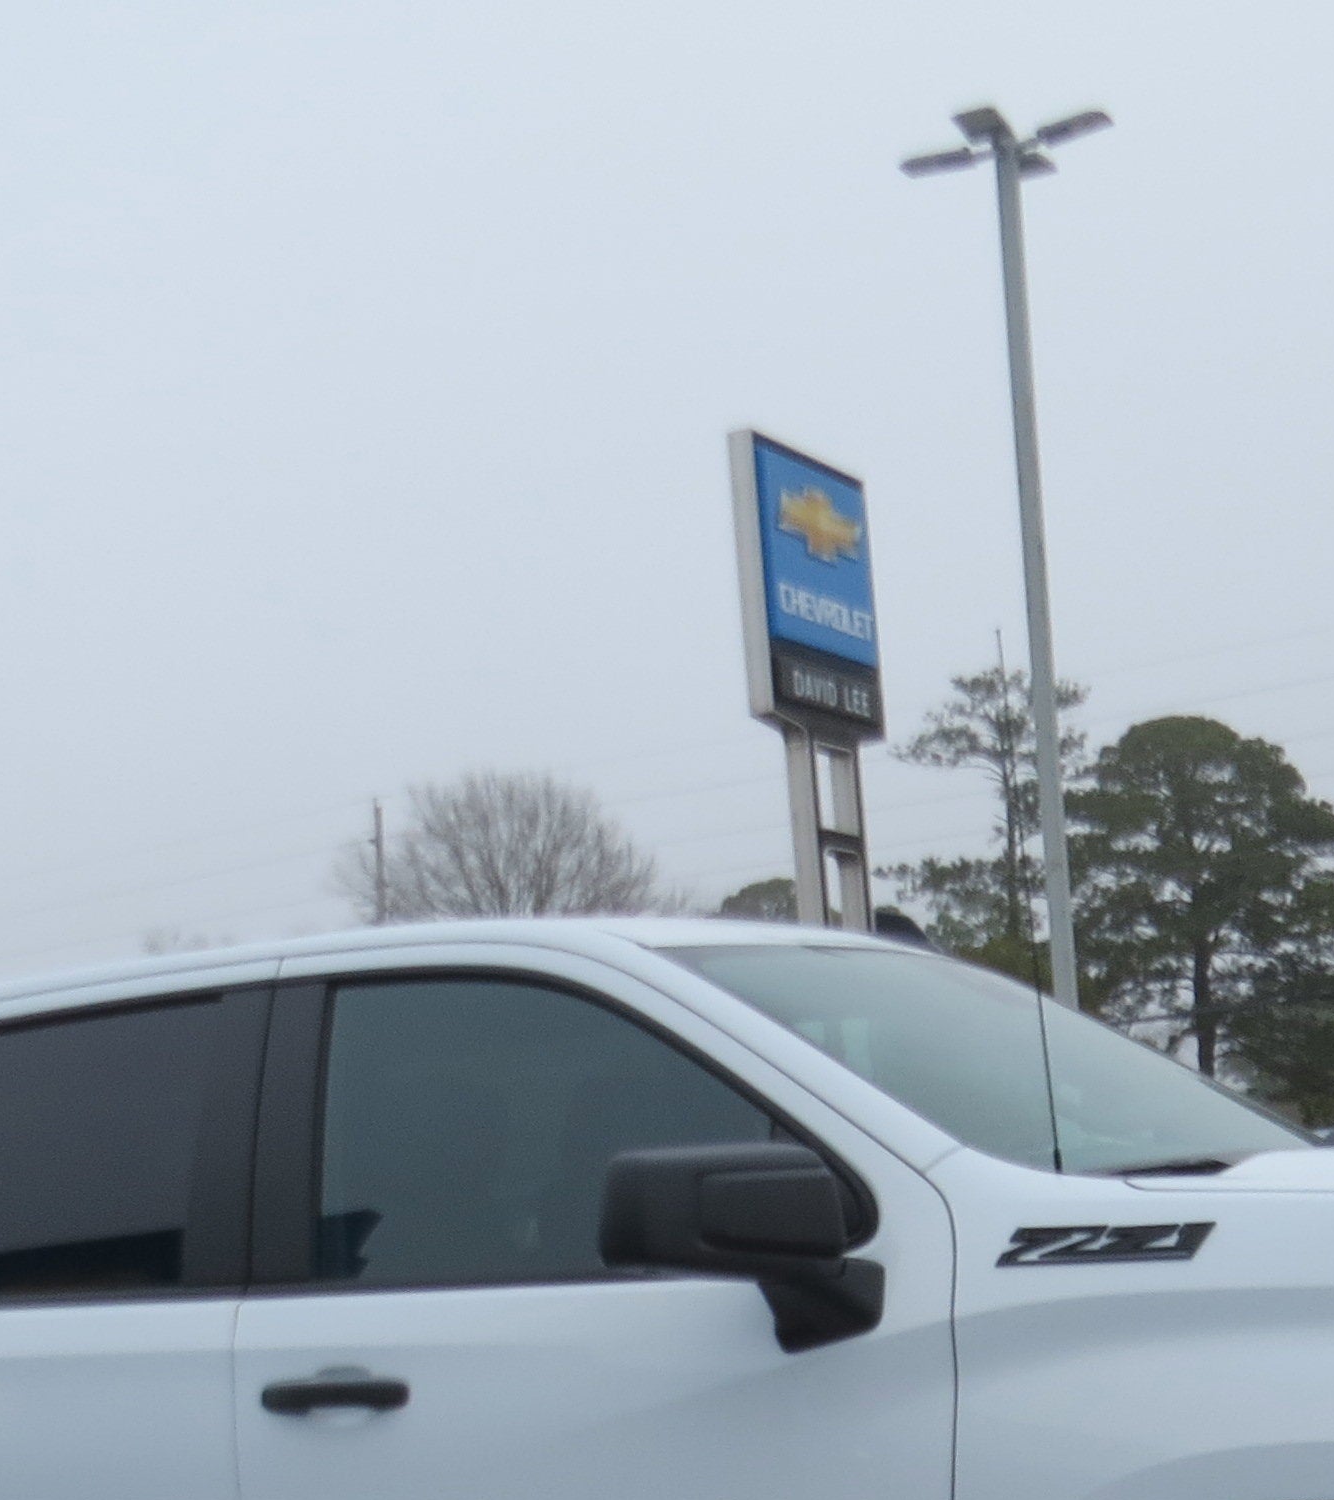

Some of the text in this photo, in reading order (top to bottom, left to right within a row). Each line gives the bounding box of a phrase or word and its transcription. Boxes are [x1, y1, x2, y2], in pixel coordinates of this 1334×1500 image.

[778, 583, 873, 641] CHEVROLET
[793, 669, 872, 719] DAVID LEE
